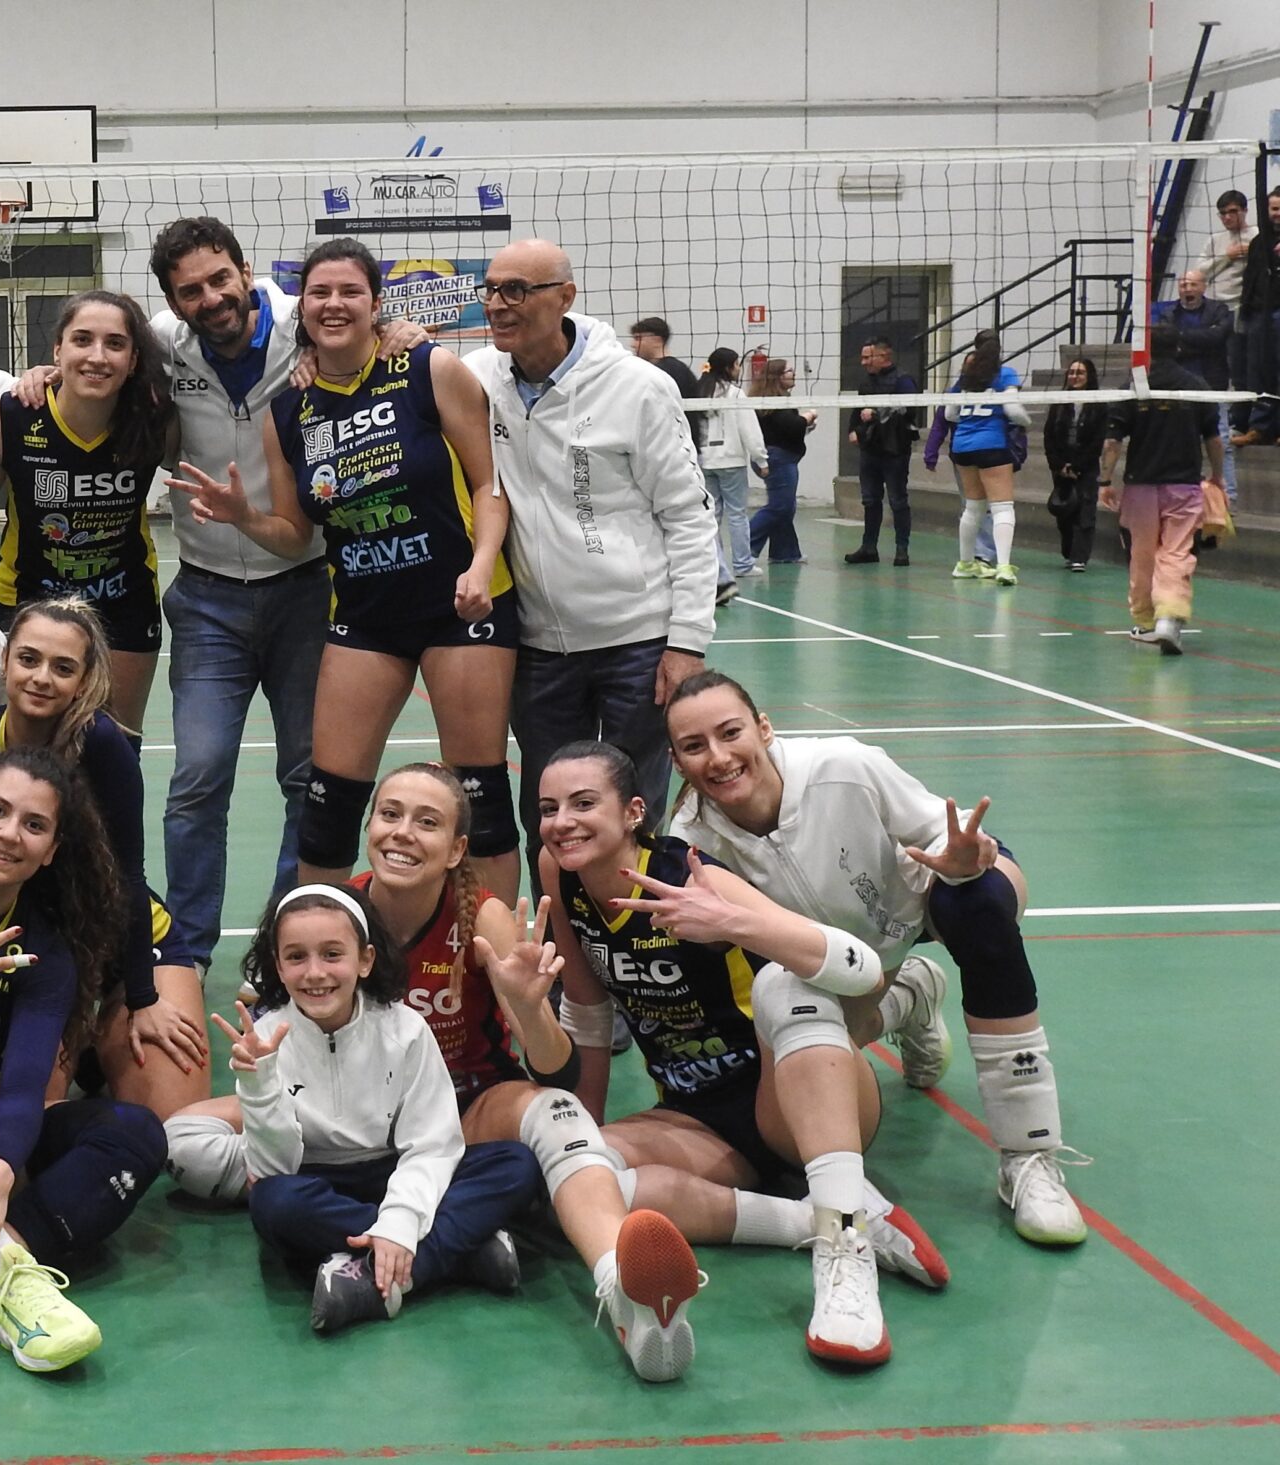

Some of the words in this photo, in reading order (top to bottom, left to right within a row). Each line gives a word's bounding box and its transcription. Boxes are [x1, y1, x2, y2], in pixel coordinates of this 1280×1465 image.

[390, 275, 473, 299] LIBERAMENTE
[410, 290, 477, 312] FEMMINILE
[387, 350, 410, 374] 18
[177, 377, 209, 391] ESG
[371, 378, 409, 397] Tradimalt
[337, 401, 396, 443] ESG
[493, 423, 510, 439] SG
[355, 427, 397, 447] INDUSTRIALI
[337, 441, 401, 470] Francesca
[338, 448, 404, 479] Giorgianni
[74, 469, 136, 497] ESG
[571, 445, 591, 501] MESSINA
[35, 501, 60, 509] PULIZIE
[62, 501, 85, 509] CIVILI
[576, 500, 604, 555] VOLLEY
[341, 532, 430, 572] SICILVET
[445, 922, 462, 952] 4
[408, 987, 462, 1017] SG
[552, 1110, 578, 1121] errea
